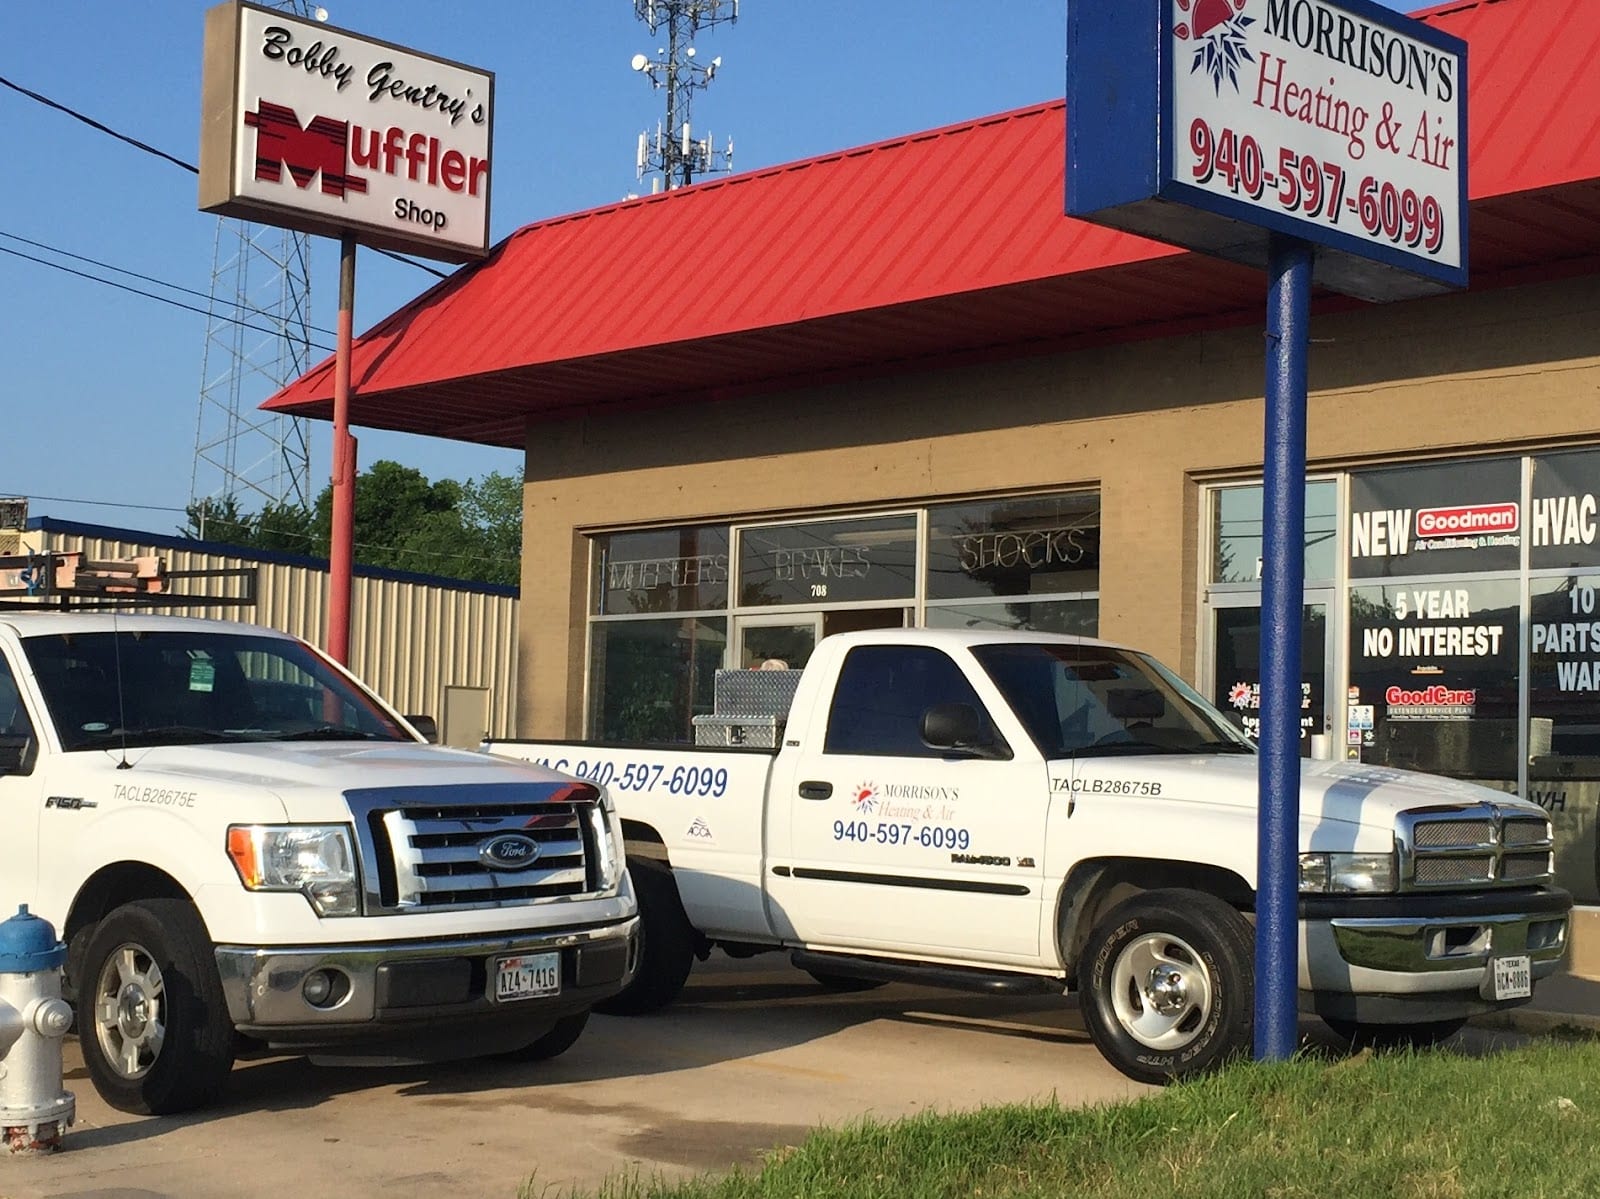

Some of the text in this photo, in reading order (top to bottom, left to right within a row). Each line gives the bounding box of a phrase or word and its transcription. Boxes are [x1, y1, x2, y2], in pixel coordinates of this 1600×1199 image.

[1263, 0, 1453, 102] MORRISON'S
[262, 26, 485, 125] Bobby Gentry's
[1253, 51, 1454, 170] Heating & Air
[244, 97, 488, 201] Muffler
[1190, 118, 1444, 255] 940-597-6099
[395, 198, 446, 230] Shop
[1352, 509, 1412, 557] NEW
[1420, 511, 1513, 530] Goodman
[1532, 494, 1597, 546] HVAC
[776, 545, 871, 581] BRAKES
[961, 528, 1085, 569] SHOCKS
[811, 584, 827, 597] 708
[1395, 590, 1469, 620] 5 YEAR
[1569, 584, 1595, 614] 10
[1363, 625, 1503, 657] NO INTEREST
[1532, 621, 1600, 653] PARTS
[1386, 685, 1476, 705] GoodCare
[575, 760, 728, 798] 940-597-6099
[884, 784, 960, 801] MORRISON'S
[1052, 778, 1162, 796] TACLB28675B
[113, 784, 198, 808] TACLB28675E
[878, 801, 921, 821] Heating
[922, 805, 934, 820] &
[501, 842, 526, 857] Ford
[833, 820, 970, 850] 940-597-6099
[1093, 919, 1139, 990] COOPER
